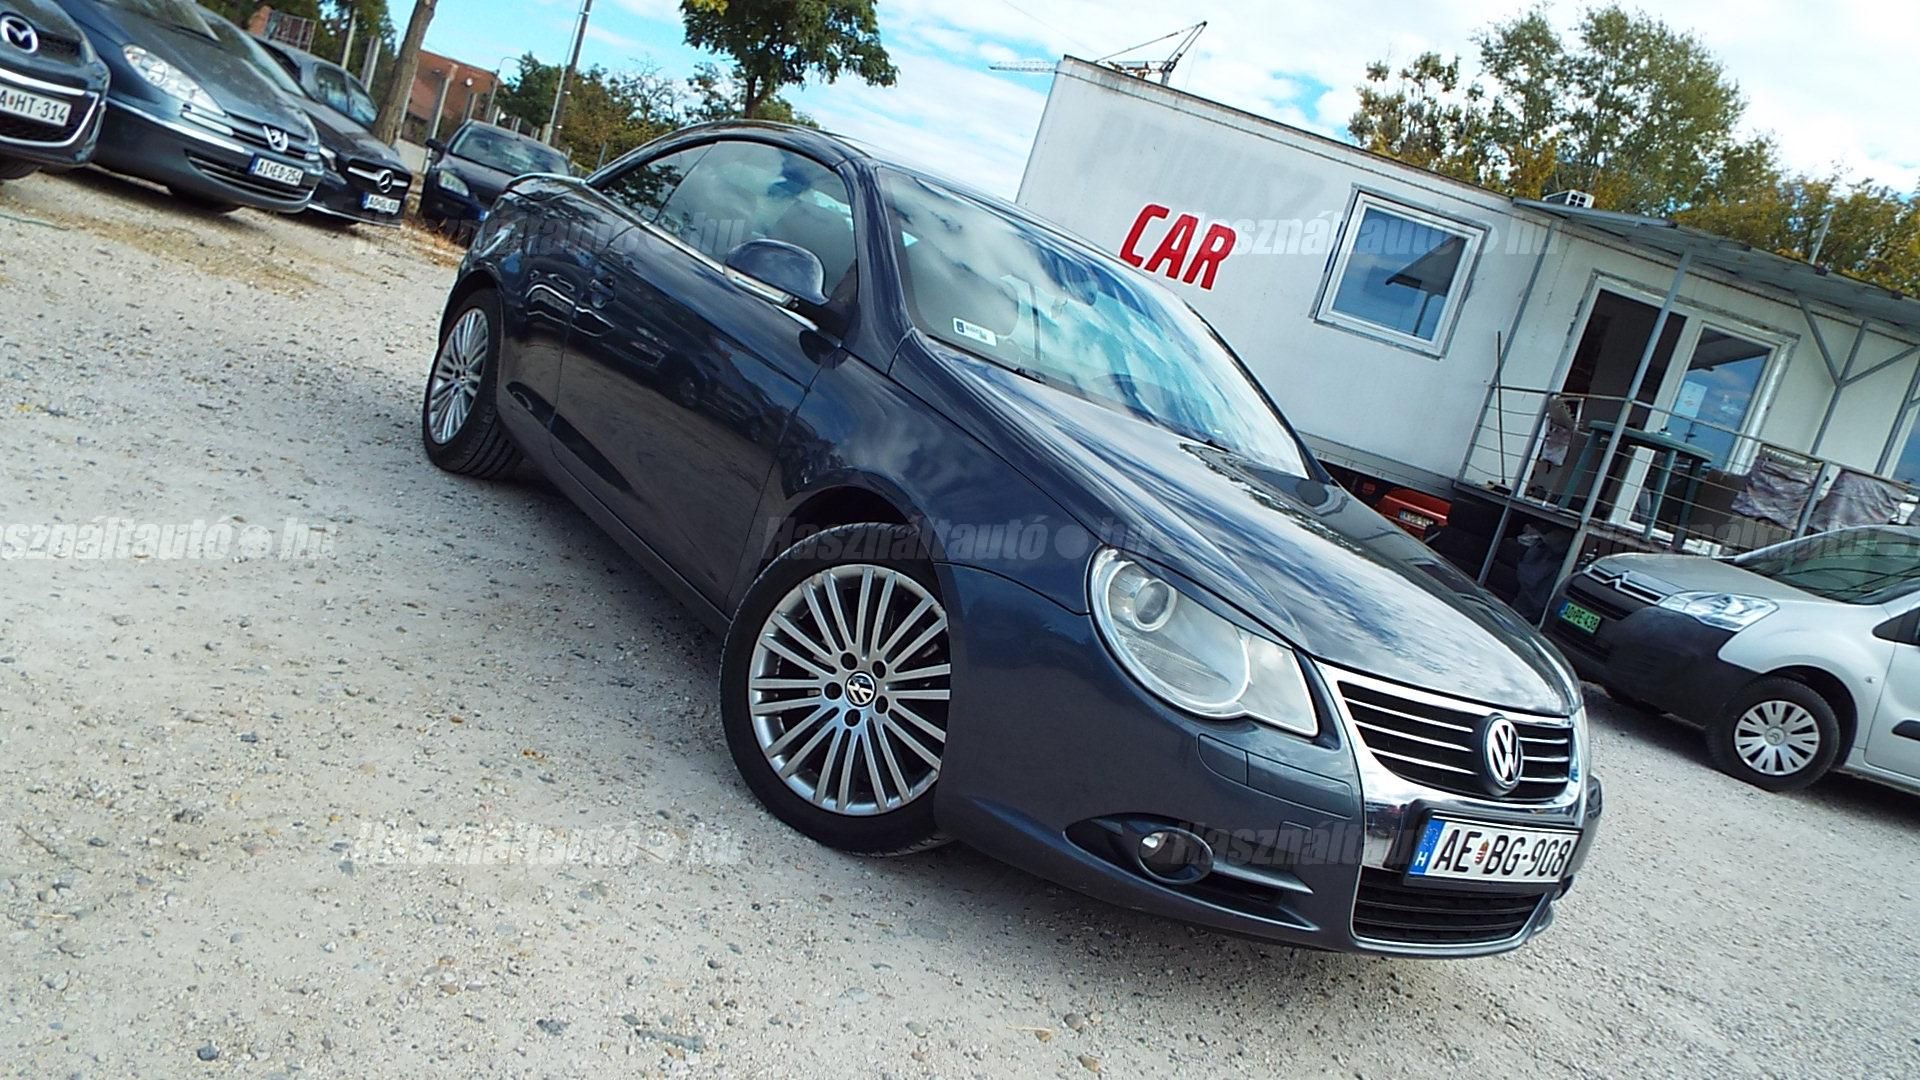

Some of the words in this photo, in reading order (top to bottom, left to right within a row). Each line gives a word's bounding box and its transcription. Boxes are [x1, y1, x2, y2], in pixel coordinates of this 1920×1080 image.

[14, 94, 67, 123] HT-314
[1119, 203, 1237, 291] CAR
[1414, 851, 1426, 867] H
[1432, 829, 1483, 872] AE
[1482, 834, 1573, 877] BG-908
